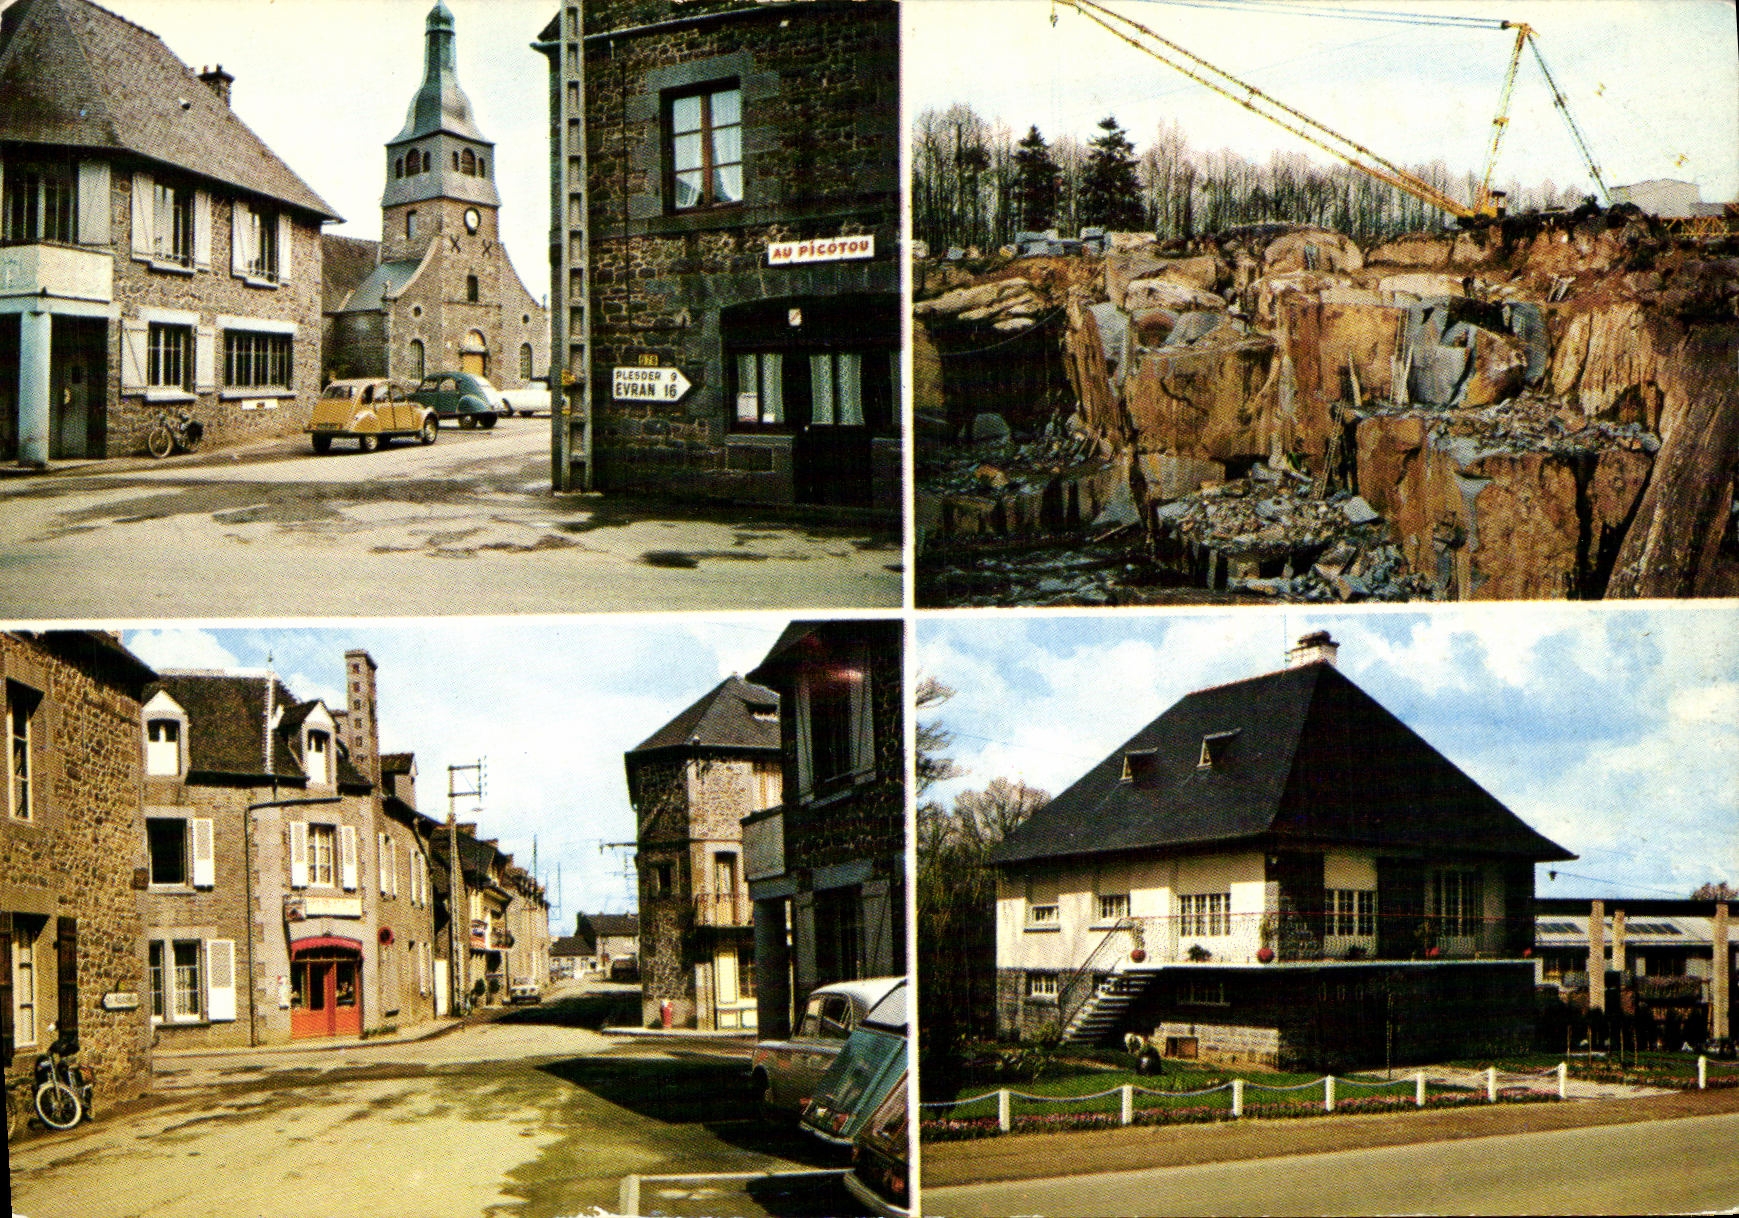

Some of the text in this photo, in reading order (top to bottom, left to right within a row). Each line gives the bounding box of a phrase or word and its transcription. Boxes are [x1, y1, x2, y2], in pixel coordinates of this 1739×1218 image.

[772, 247, 793, 259] AU
[616, 371, 677, 381] PLESDER 9
[616, 382, 677, 398] EVRAN 16
